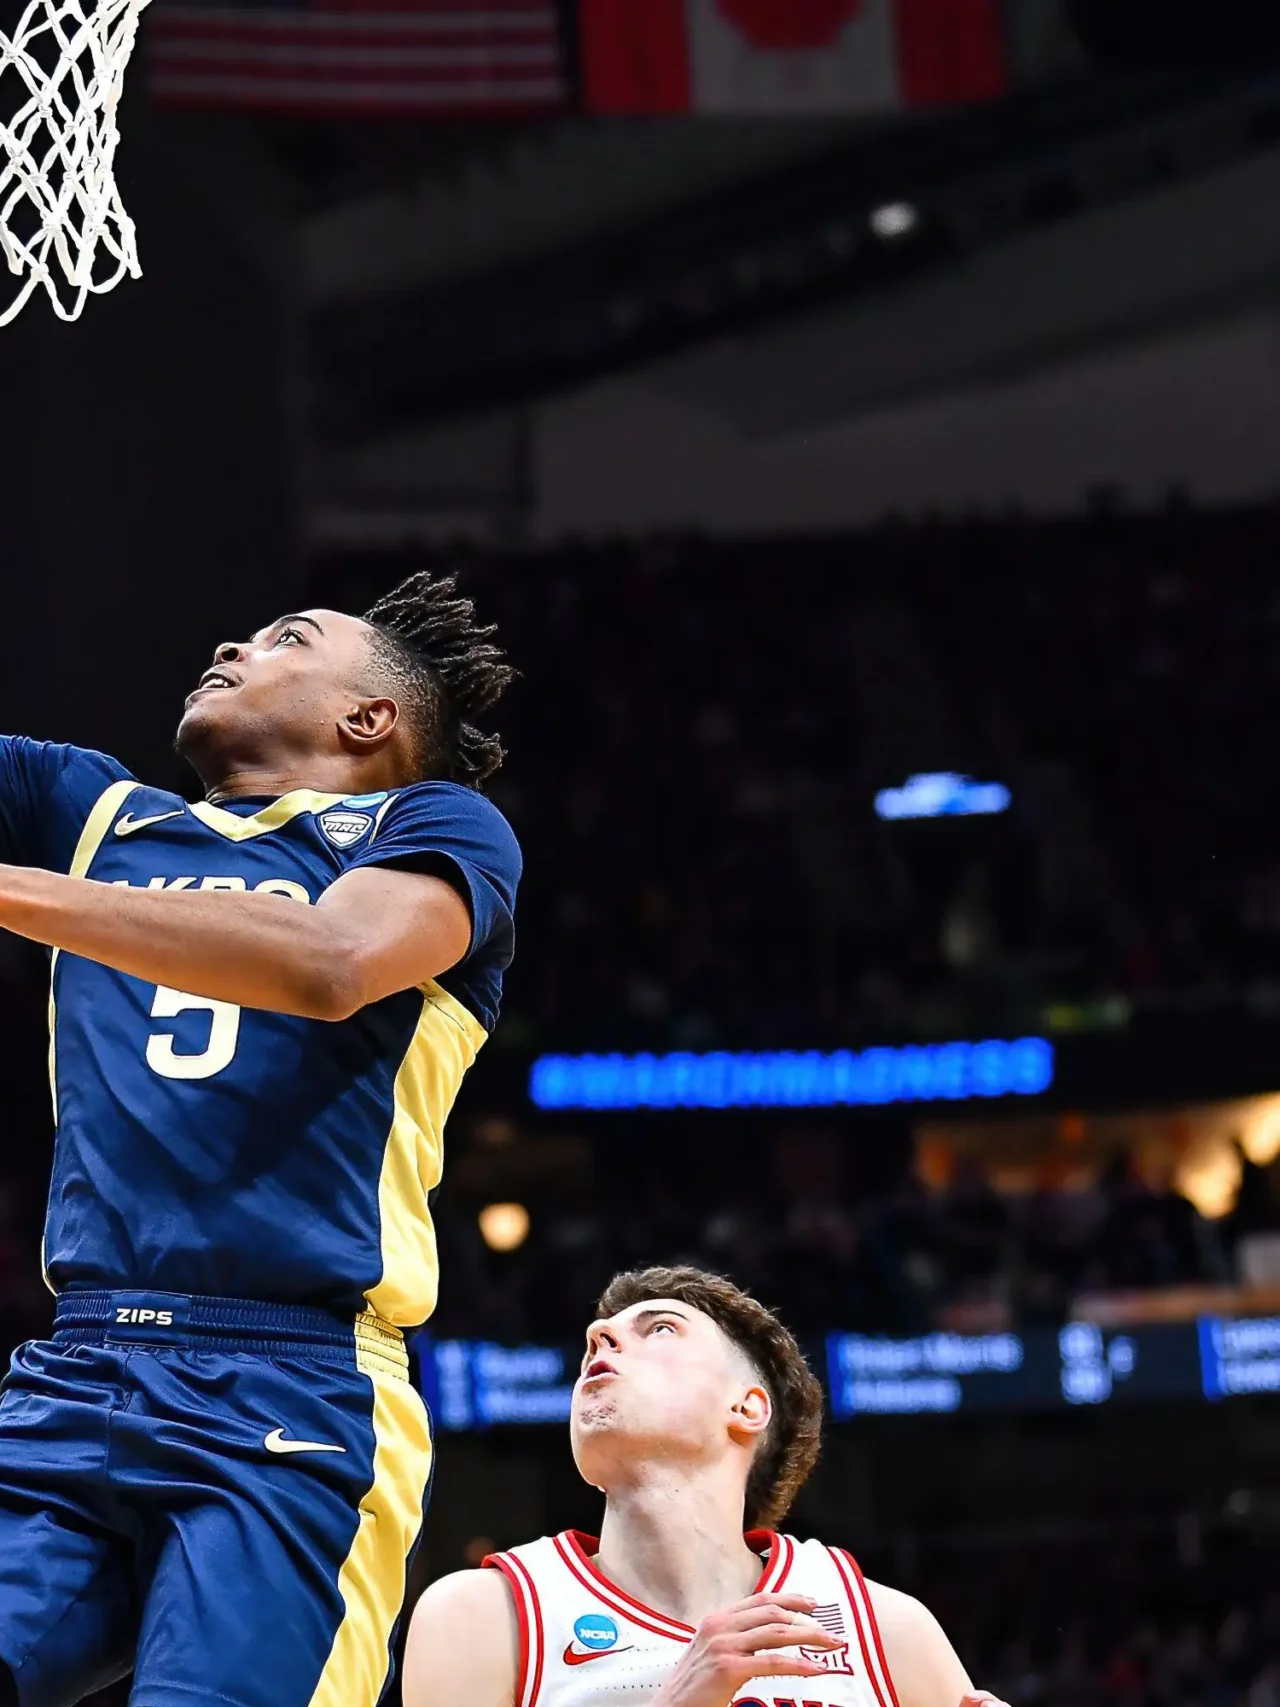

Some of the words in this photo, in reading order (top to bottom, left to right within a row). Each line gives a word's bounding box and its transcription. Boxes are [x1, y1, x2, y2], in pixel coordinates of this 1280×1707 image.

[325, 821, 366, 834] MAC
[146, 984, 241, 1079] 5
[116, 1308, 173, 1325] ZIPS
[580, 1628, 616, 1641] NCAA
